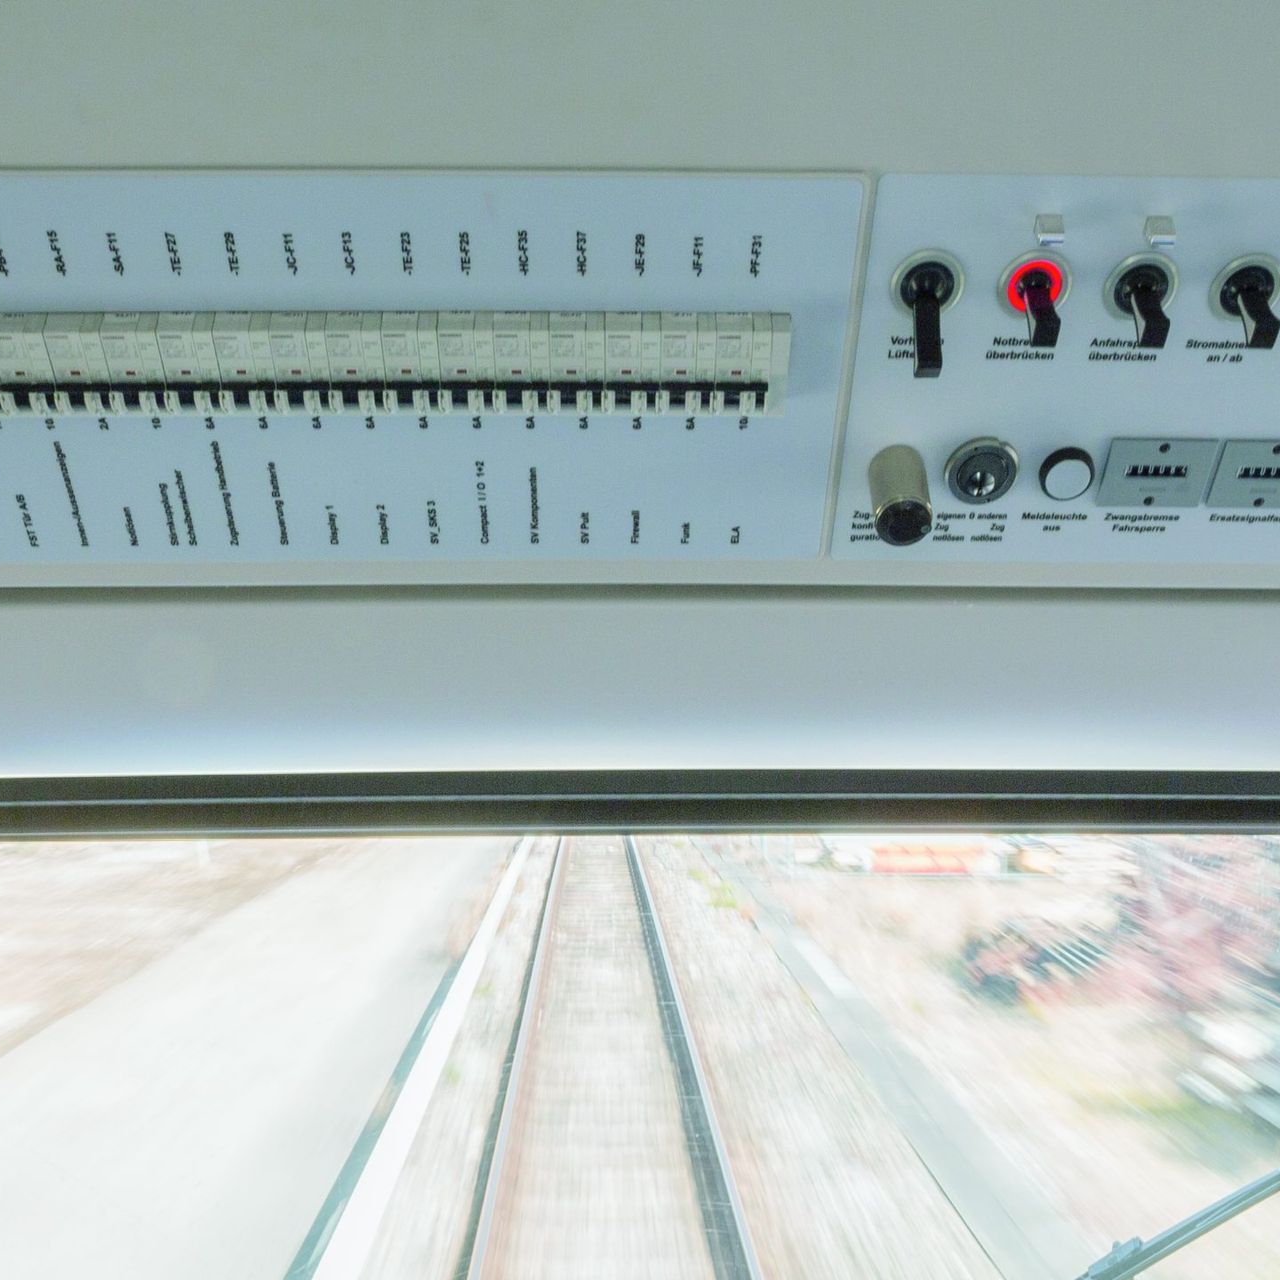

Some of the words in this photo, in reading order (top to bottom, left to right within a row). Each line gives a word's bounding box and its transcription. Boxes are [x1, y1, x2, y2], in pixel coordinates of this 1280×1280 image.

[985, 350, 1054, 360] überbrücken
[1088, 352, 1157, 361] überbrücken
[1021, 512, 1088, 520] Meldeleuchte
[1104, 513, 1180, 522] Zwangsbremse
